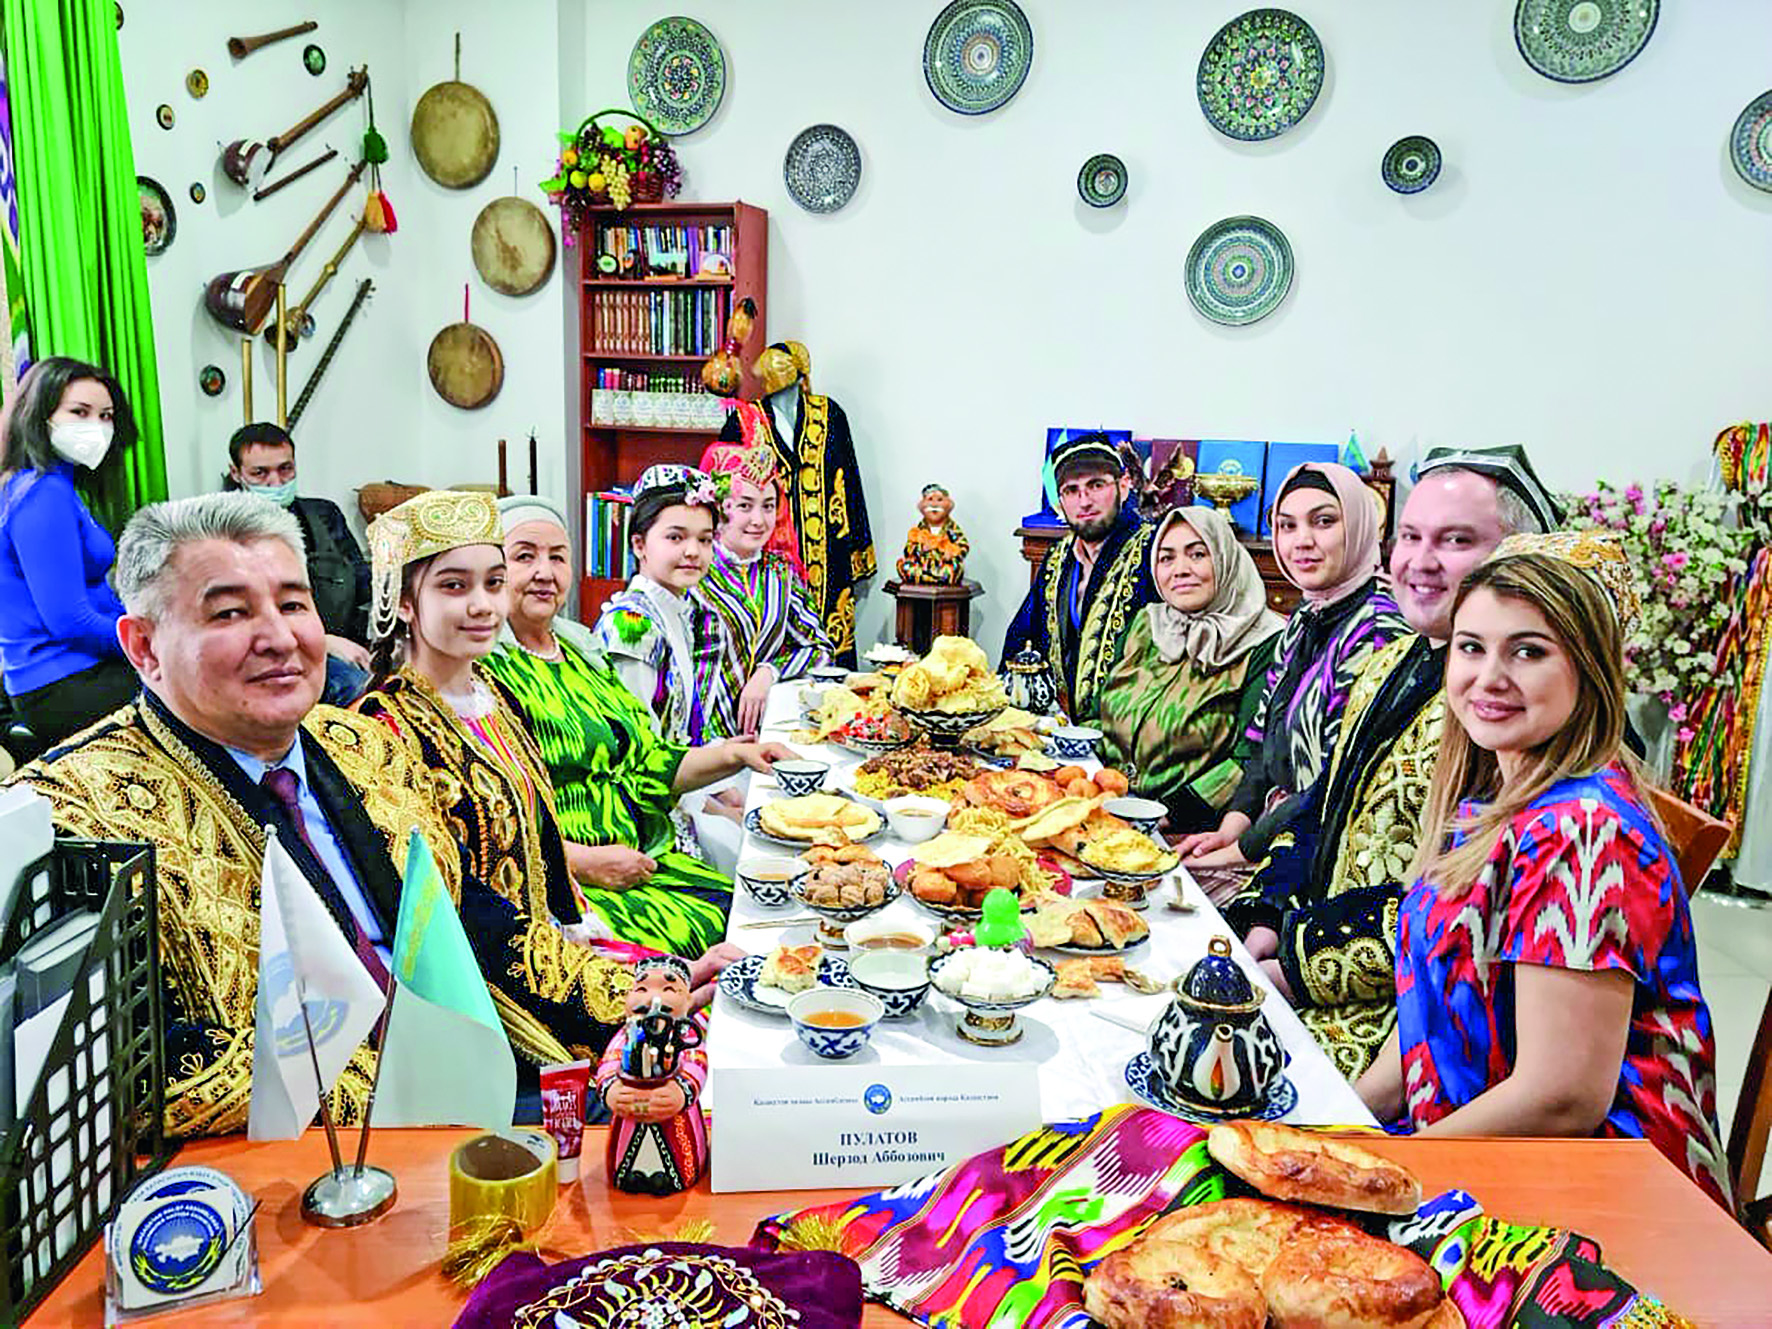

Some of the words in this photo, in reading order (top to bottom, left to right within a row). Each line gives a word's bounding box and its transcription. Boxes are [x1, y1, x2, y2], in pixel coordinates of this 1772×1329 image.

[840, 1131, 918, 1146] ПУЛАТОВ
[812, 1152, 868, 1168] Шерзод
[872, 1149, 946, 1164] Аббозович
